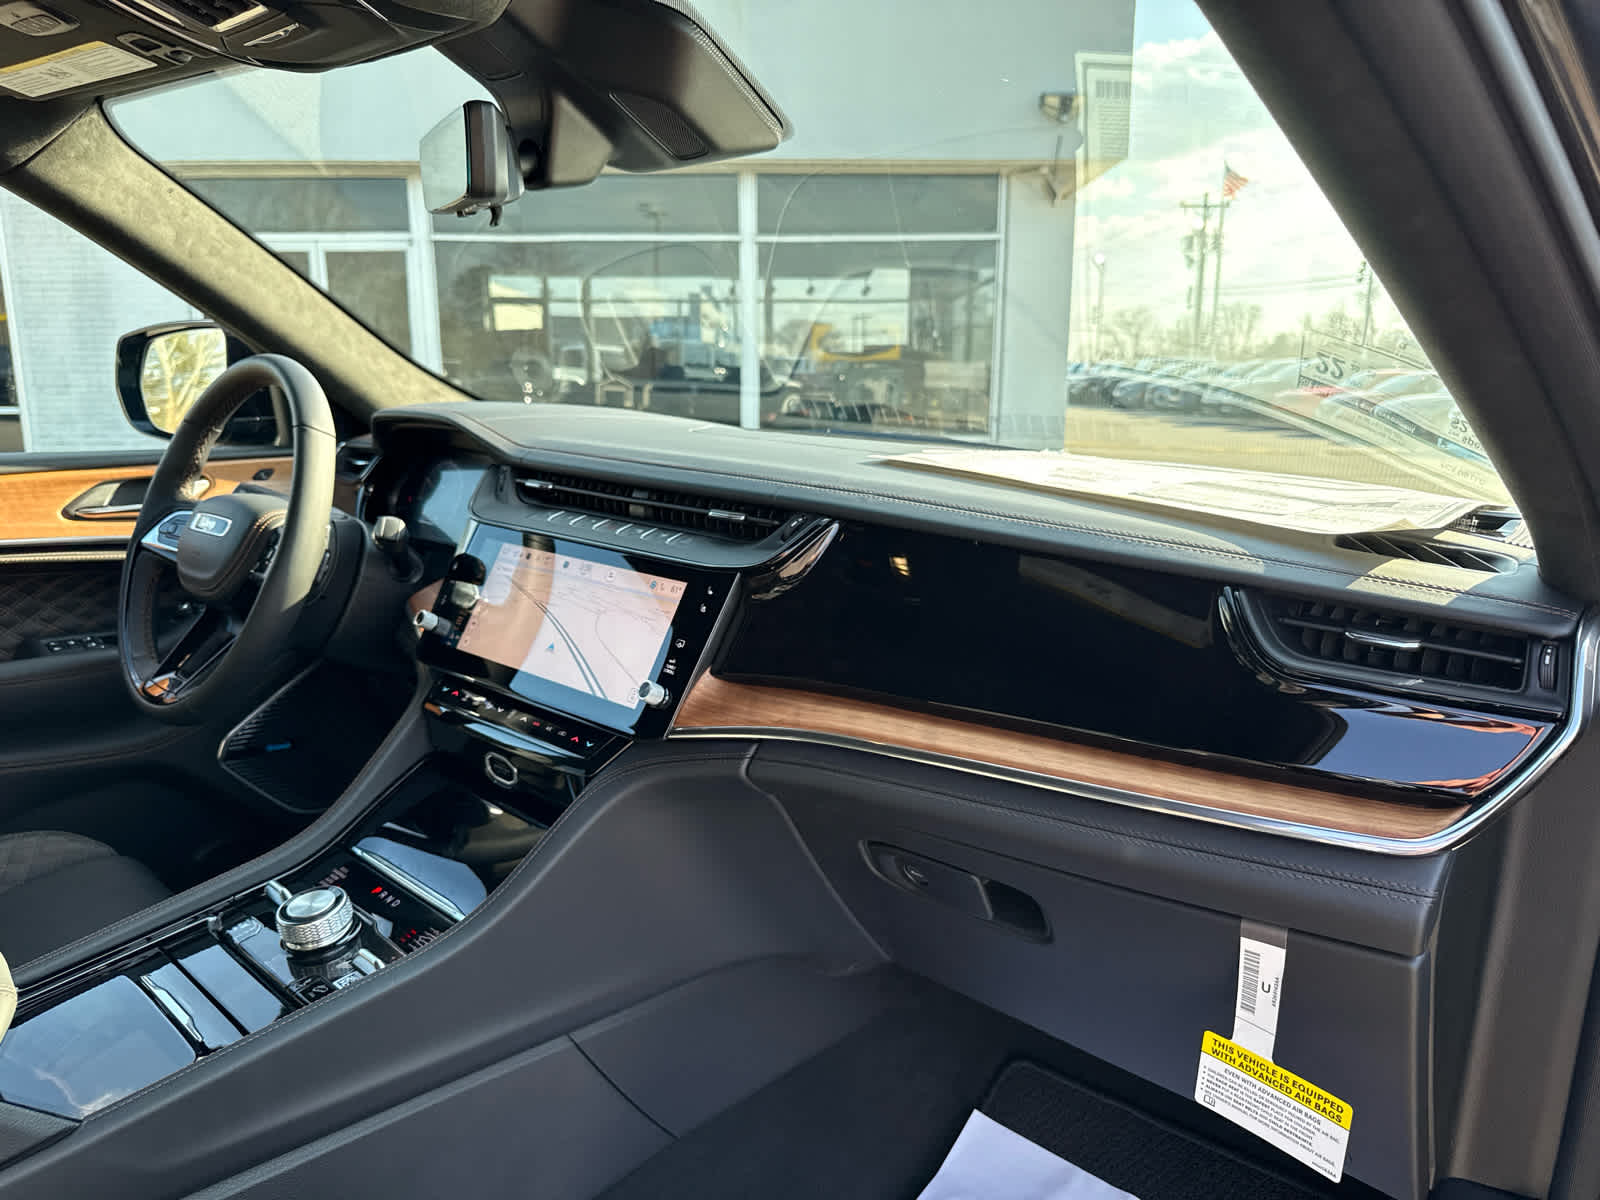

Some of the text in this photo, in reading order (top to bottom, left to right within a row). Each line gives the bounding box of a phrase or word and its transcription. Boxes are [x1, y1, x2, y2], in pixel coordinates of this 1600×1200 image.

[1211, 1046, 1343, 1123] WITH ADVANCED AIR BAGS
[1212, 1038, 1344, 1114] THIS VEHICLE IS EQUIPPED
[1224, 1068, 1321, 1125] EVEN WITH ADVANCED AIR BAGS
